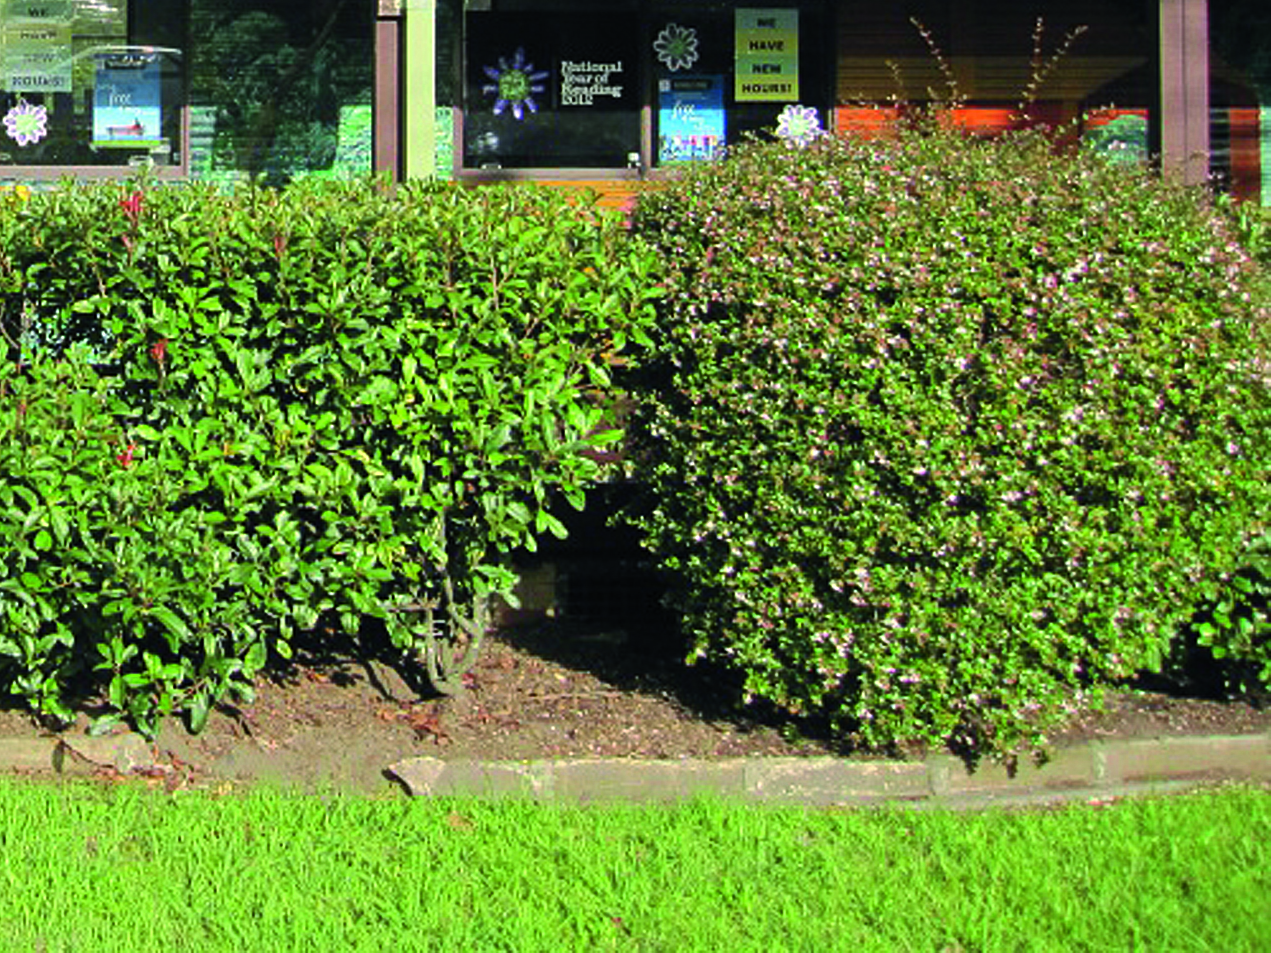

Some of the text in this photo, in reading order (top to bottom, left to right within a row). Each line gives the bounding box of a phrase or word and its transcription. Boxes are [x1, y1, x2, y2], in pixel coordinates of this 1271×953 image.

[749, 40, 784, 51] HAVE
[561, 60, 622, 72] National
[565, 72, 609, 84] Year of
[561, 83, 623, 97] Reading
